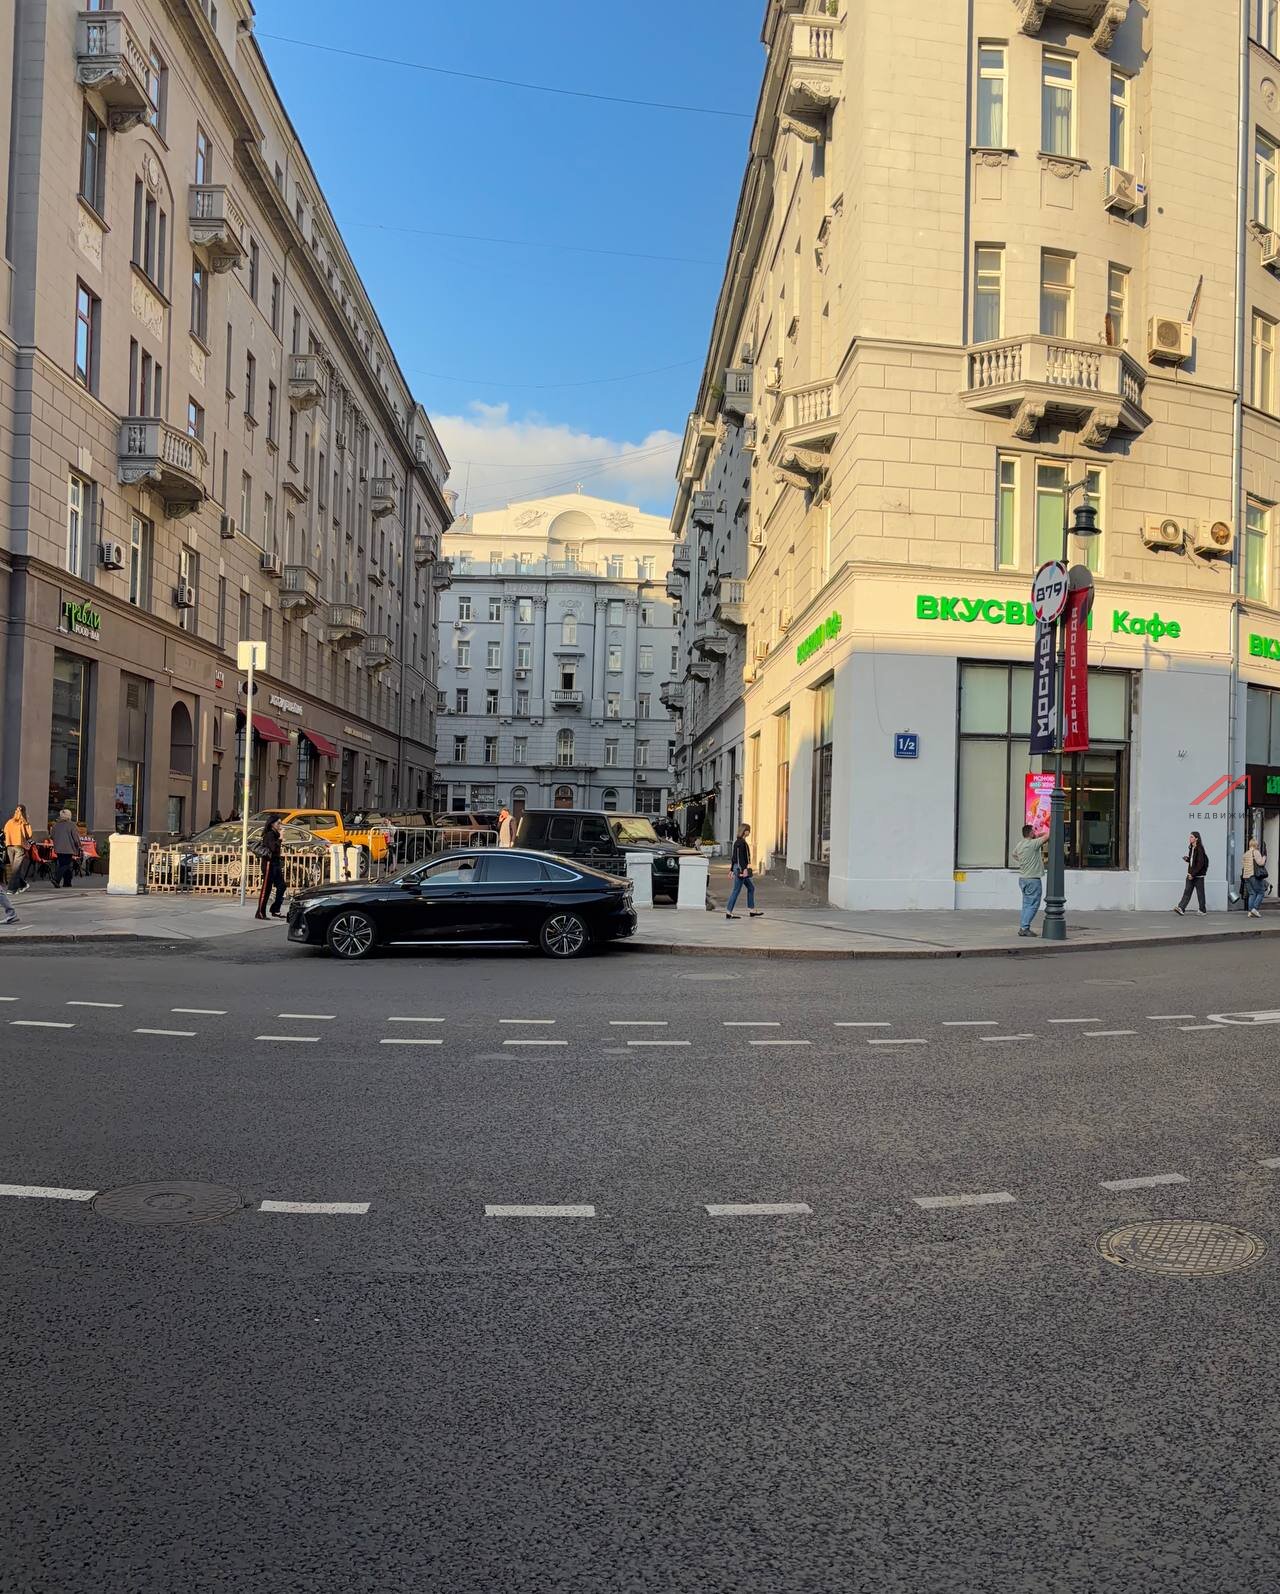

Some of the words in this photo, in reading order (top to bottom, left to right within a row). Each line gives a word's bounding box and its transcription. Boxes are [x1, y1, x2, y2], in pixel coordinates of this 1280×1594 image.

[1036, 582, 1063, 602] 879
[916, 594, 1092, 631] ВКУСВ
[1112, 609, 1181, 642] Кафе
[1070, 606, 1078, 680] ГОРОДА
[899, 738, 915, 751] 1/2
